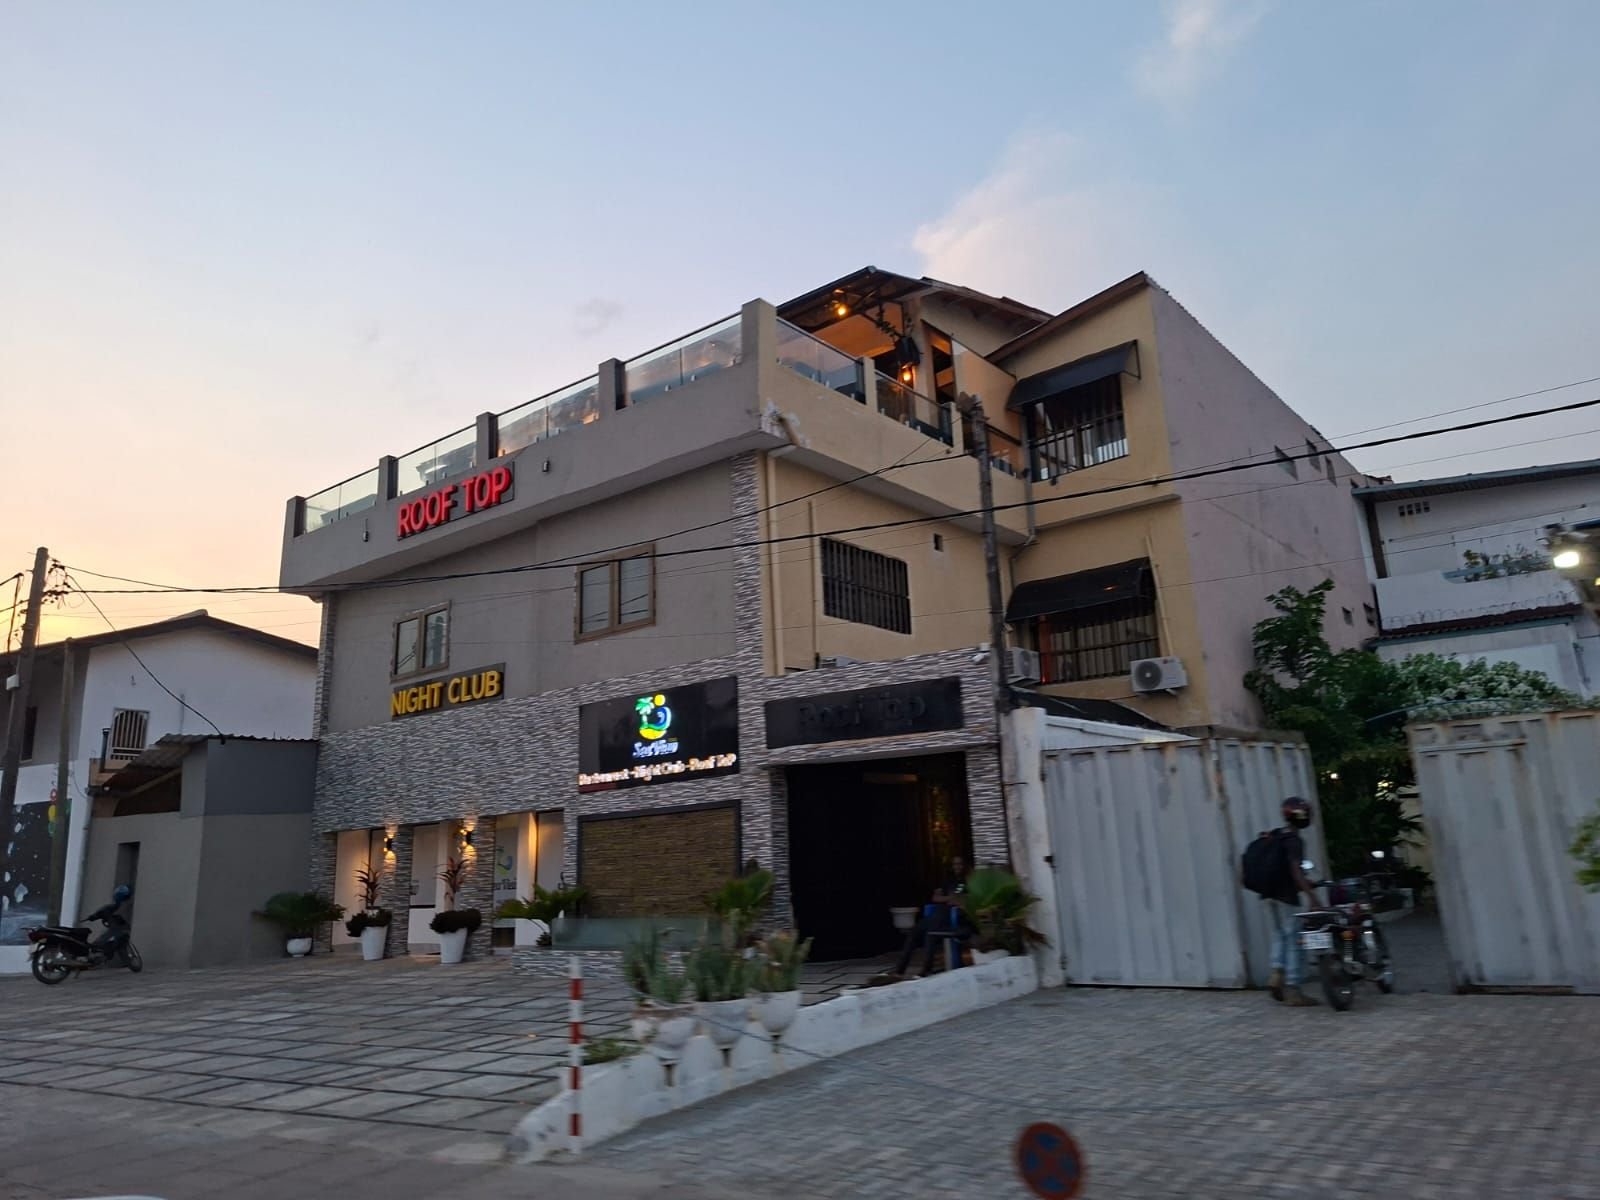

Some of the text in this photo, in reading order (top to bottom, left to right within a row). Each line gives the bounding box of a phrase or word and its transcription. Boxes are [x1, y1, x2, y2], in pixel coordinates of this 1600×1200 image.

[397, 467, 511, 536] ROOF TOP
[391, 670, 500, 716] NIGHT CLUB
